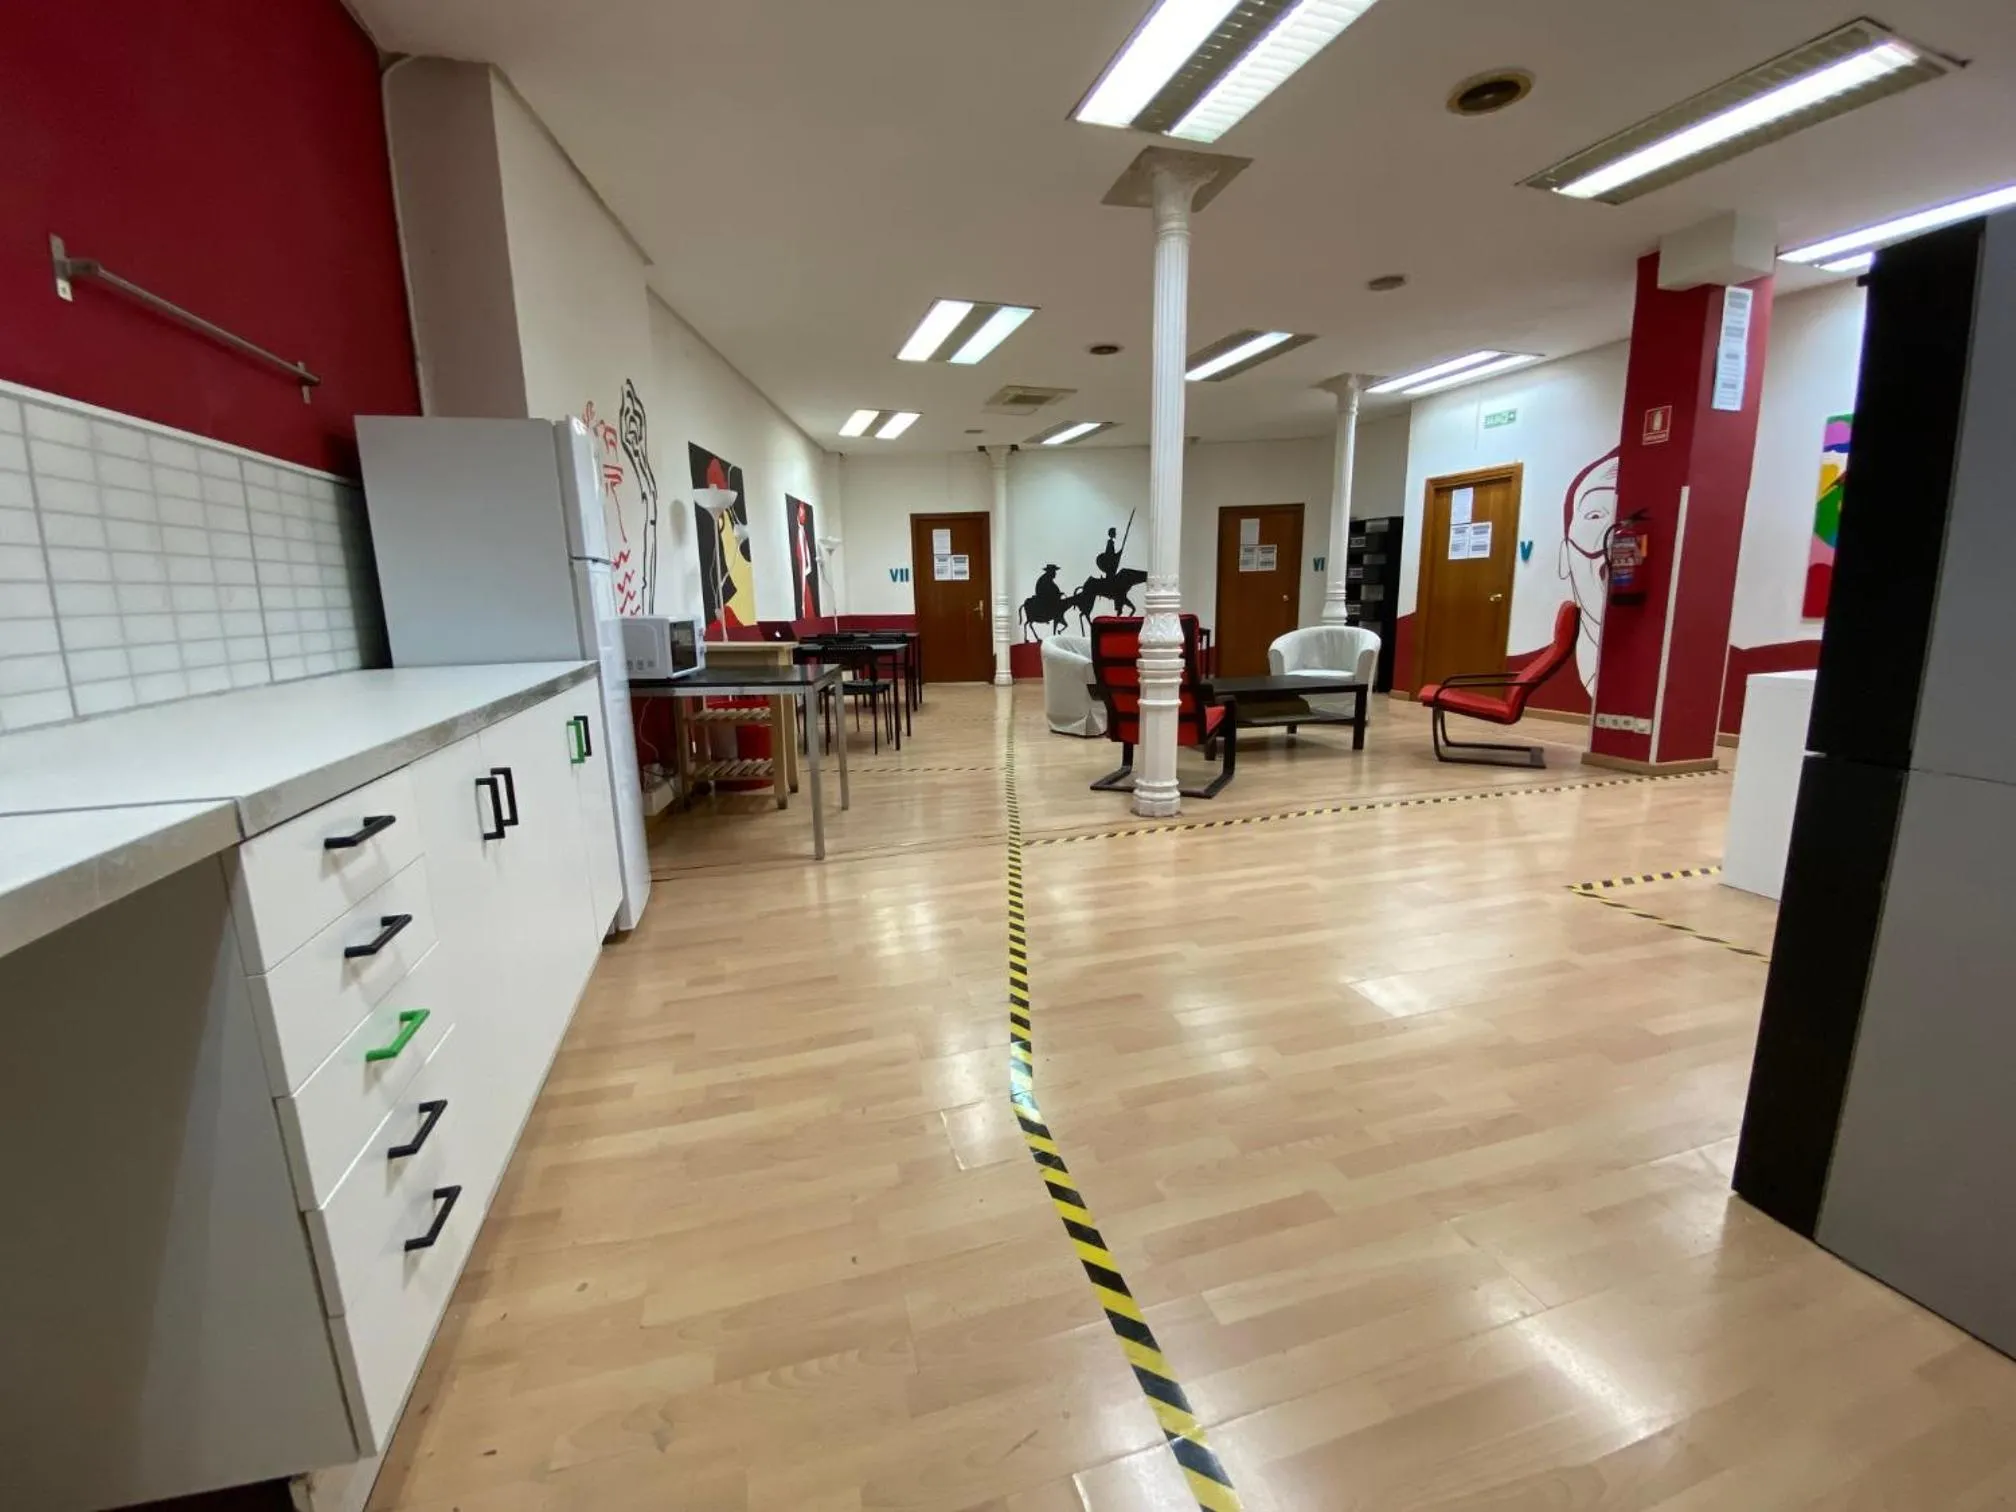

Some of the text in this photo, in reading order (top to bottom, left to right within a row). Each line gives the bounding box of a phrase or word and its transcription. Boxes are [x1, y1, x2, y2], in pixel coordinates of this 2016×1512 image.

[1520, 541, 1533, 562] V
[1313, 557, 1325, 572] VI
[889, 568, 909, 582] VII
